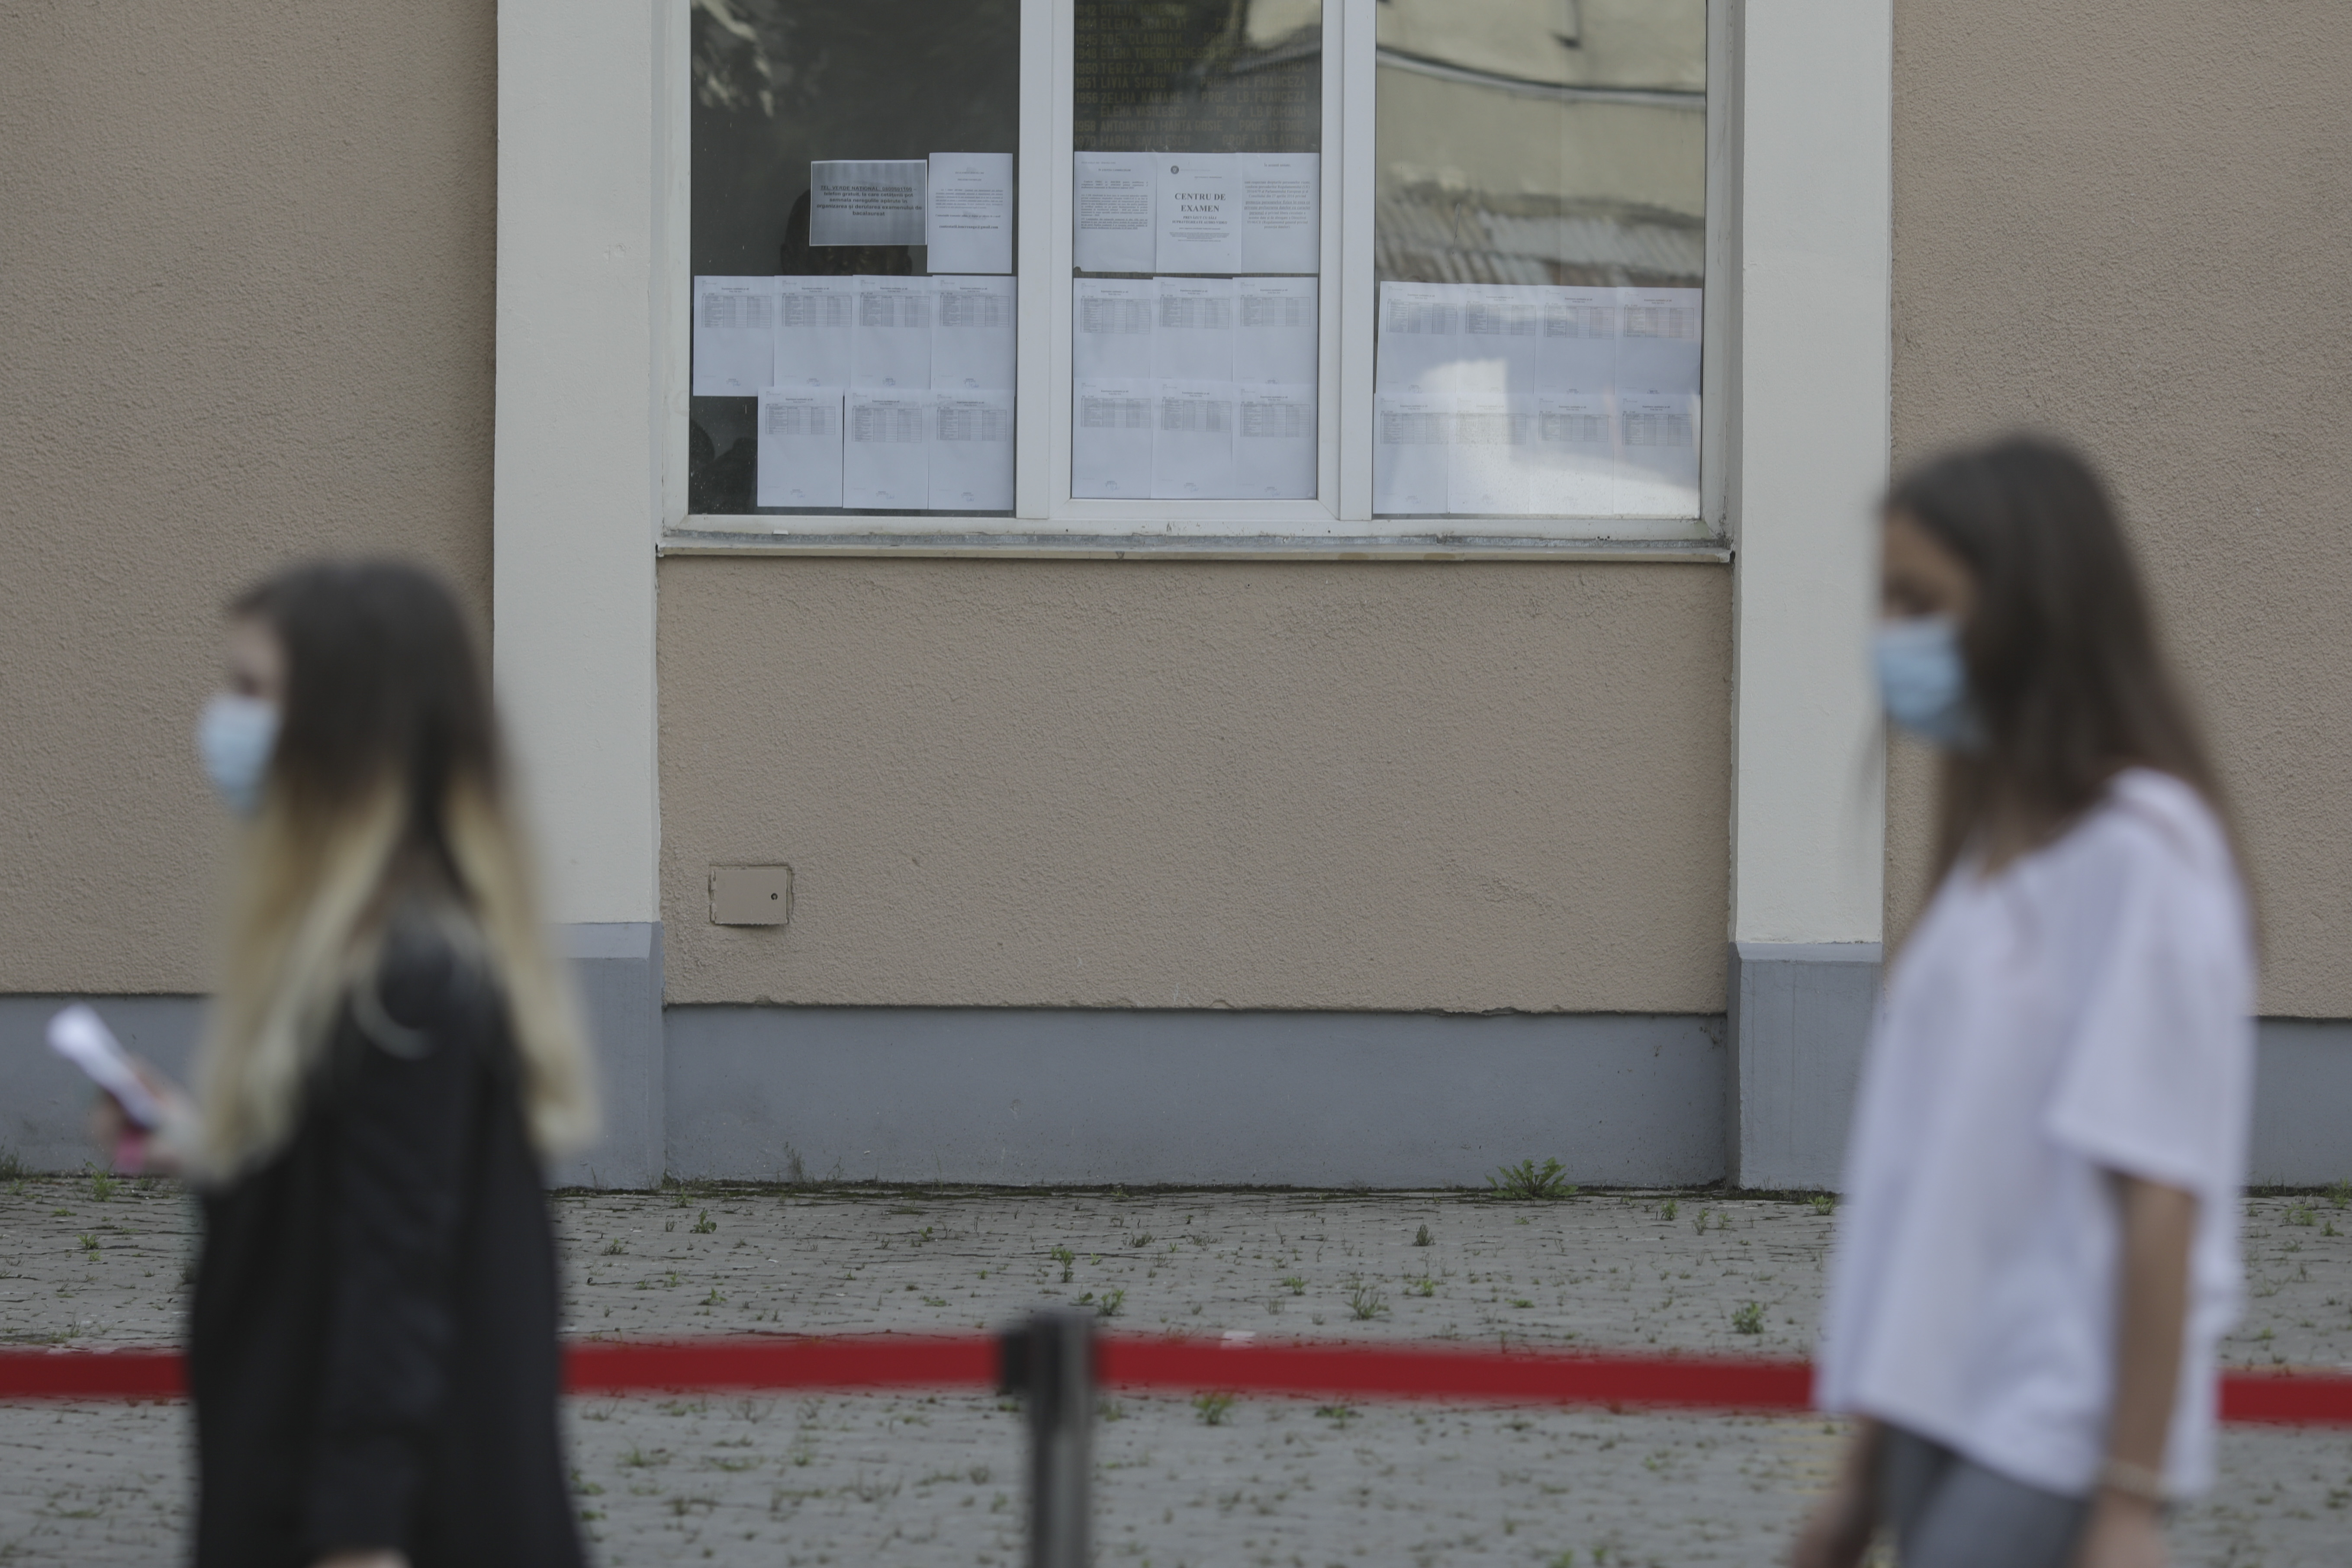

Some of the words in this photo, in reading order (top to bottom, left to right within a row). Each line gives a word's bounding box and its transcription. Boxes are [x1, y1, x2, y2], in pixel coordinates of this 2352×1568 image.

[1075, 62, 1098, 74] 1950
[1101, 62, 1145, 74] TEREZA
[1075, 77, 1096, 88] 1951
[1100, 77, 1129, 88] LIVIA
[1254, 77, 1306, 88] FRANCEZA
[1255, 92, 1306, 103] FRANCEZA
